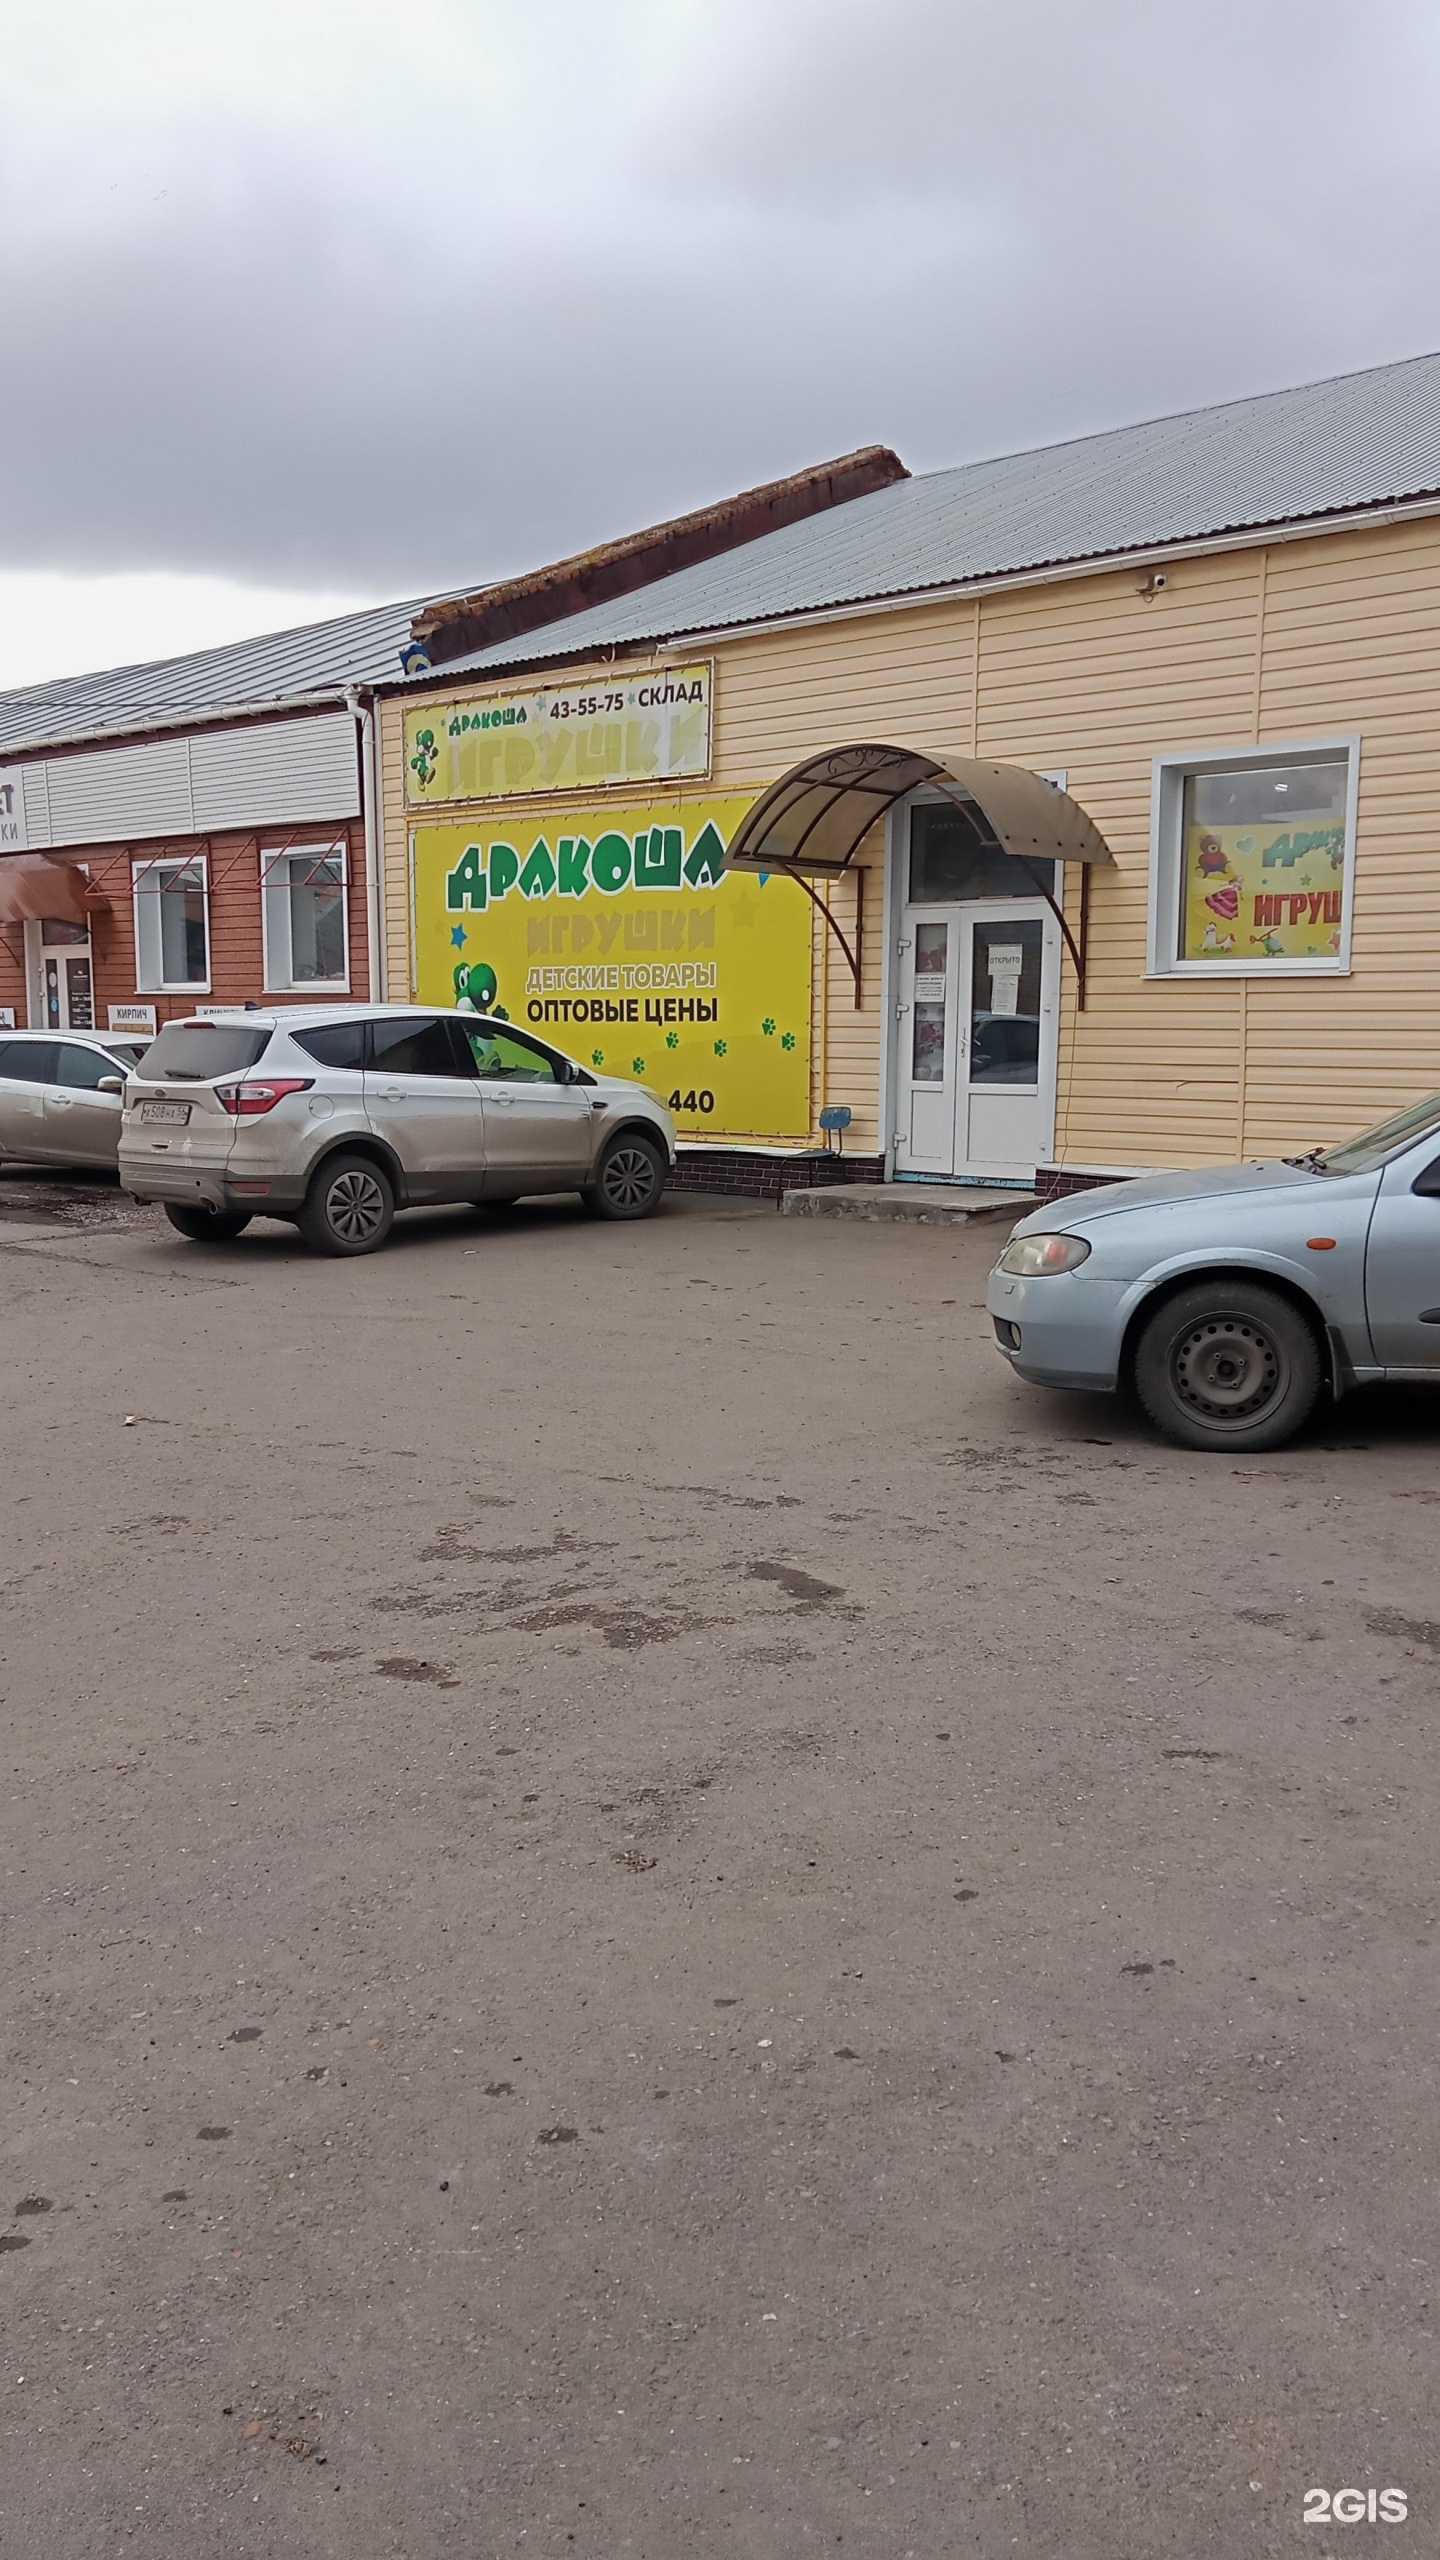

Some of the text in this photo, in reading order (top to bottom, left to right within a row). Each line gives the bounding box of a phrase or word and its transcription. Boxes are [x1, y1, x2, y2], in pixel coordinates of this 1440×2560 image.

[448, 680, 703, 737] ДРАКОША 43-55-75 СКЛАД
[447, 819, 728, 911] ДРАКОША
[528, 905, 716, 957] ИГРУШКИ
[526, 961, 717, 994] ДЕТСКИЕ ТОВАРЫ
[116, 1008, 148, 1020] КИРПИЧ
[527, 997, 718, 1026] ОПТОВЫЕ ЦЕНЫ
[668, 1089, 715, 1114] 440
